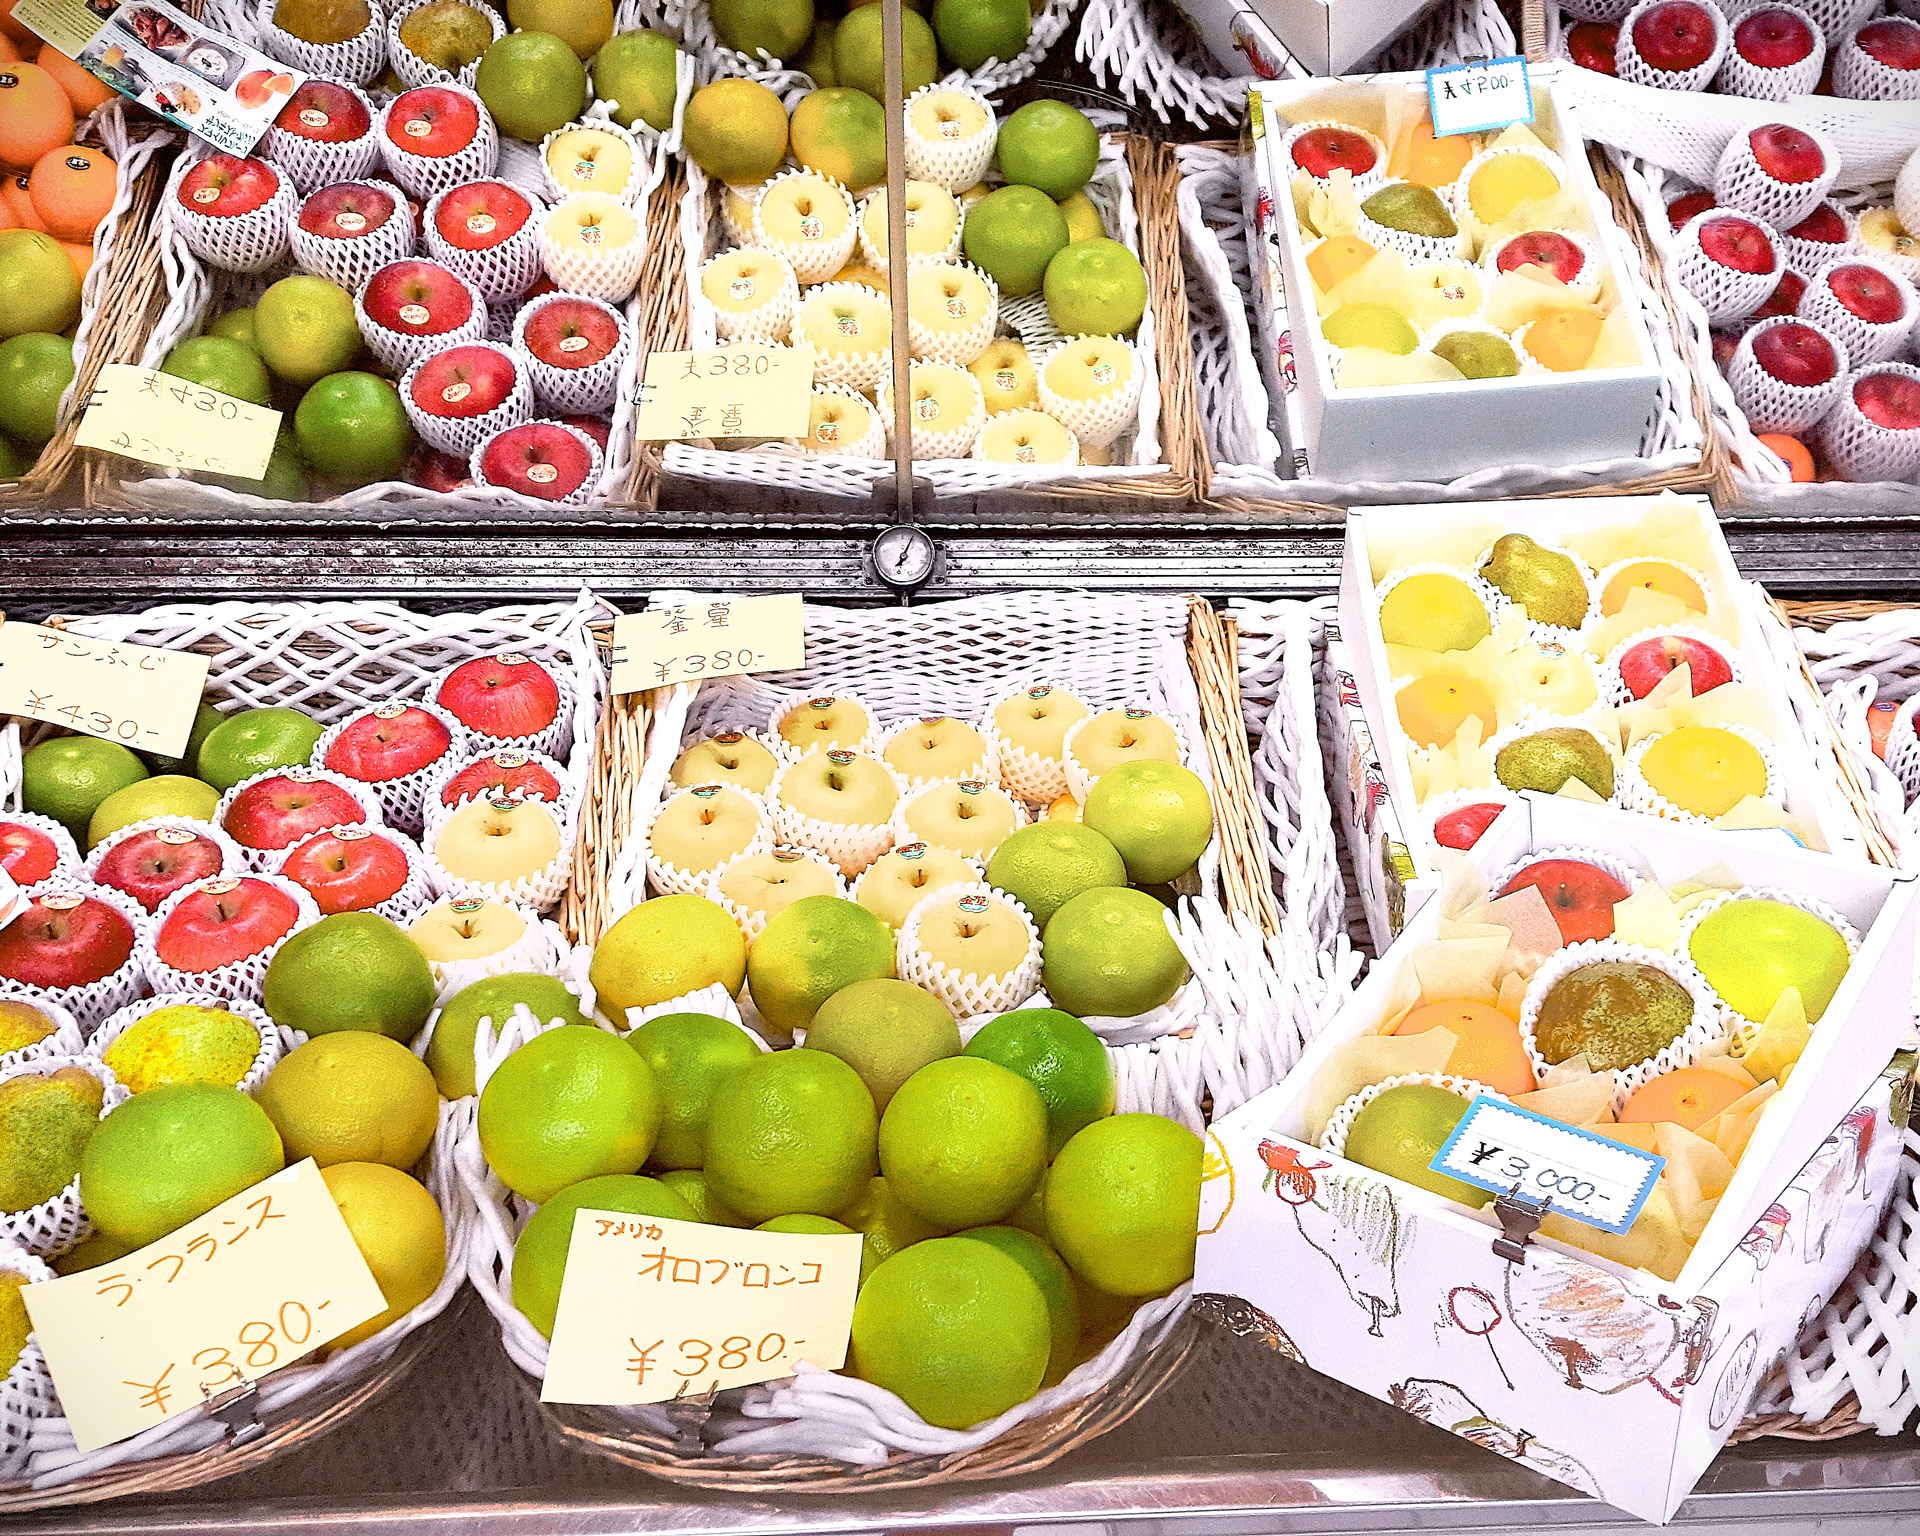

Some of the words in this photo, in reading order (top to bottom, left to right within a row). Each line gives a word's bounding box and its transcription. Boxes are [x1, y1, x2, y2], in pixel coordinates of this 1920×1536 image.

[37, 634, 166, 671] サンふじ
[595, 1219, 664, 1241] アメリカ
[637, 1246, 823, 1289] オロブロンコ
